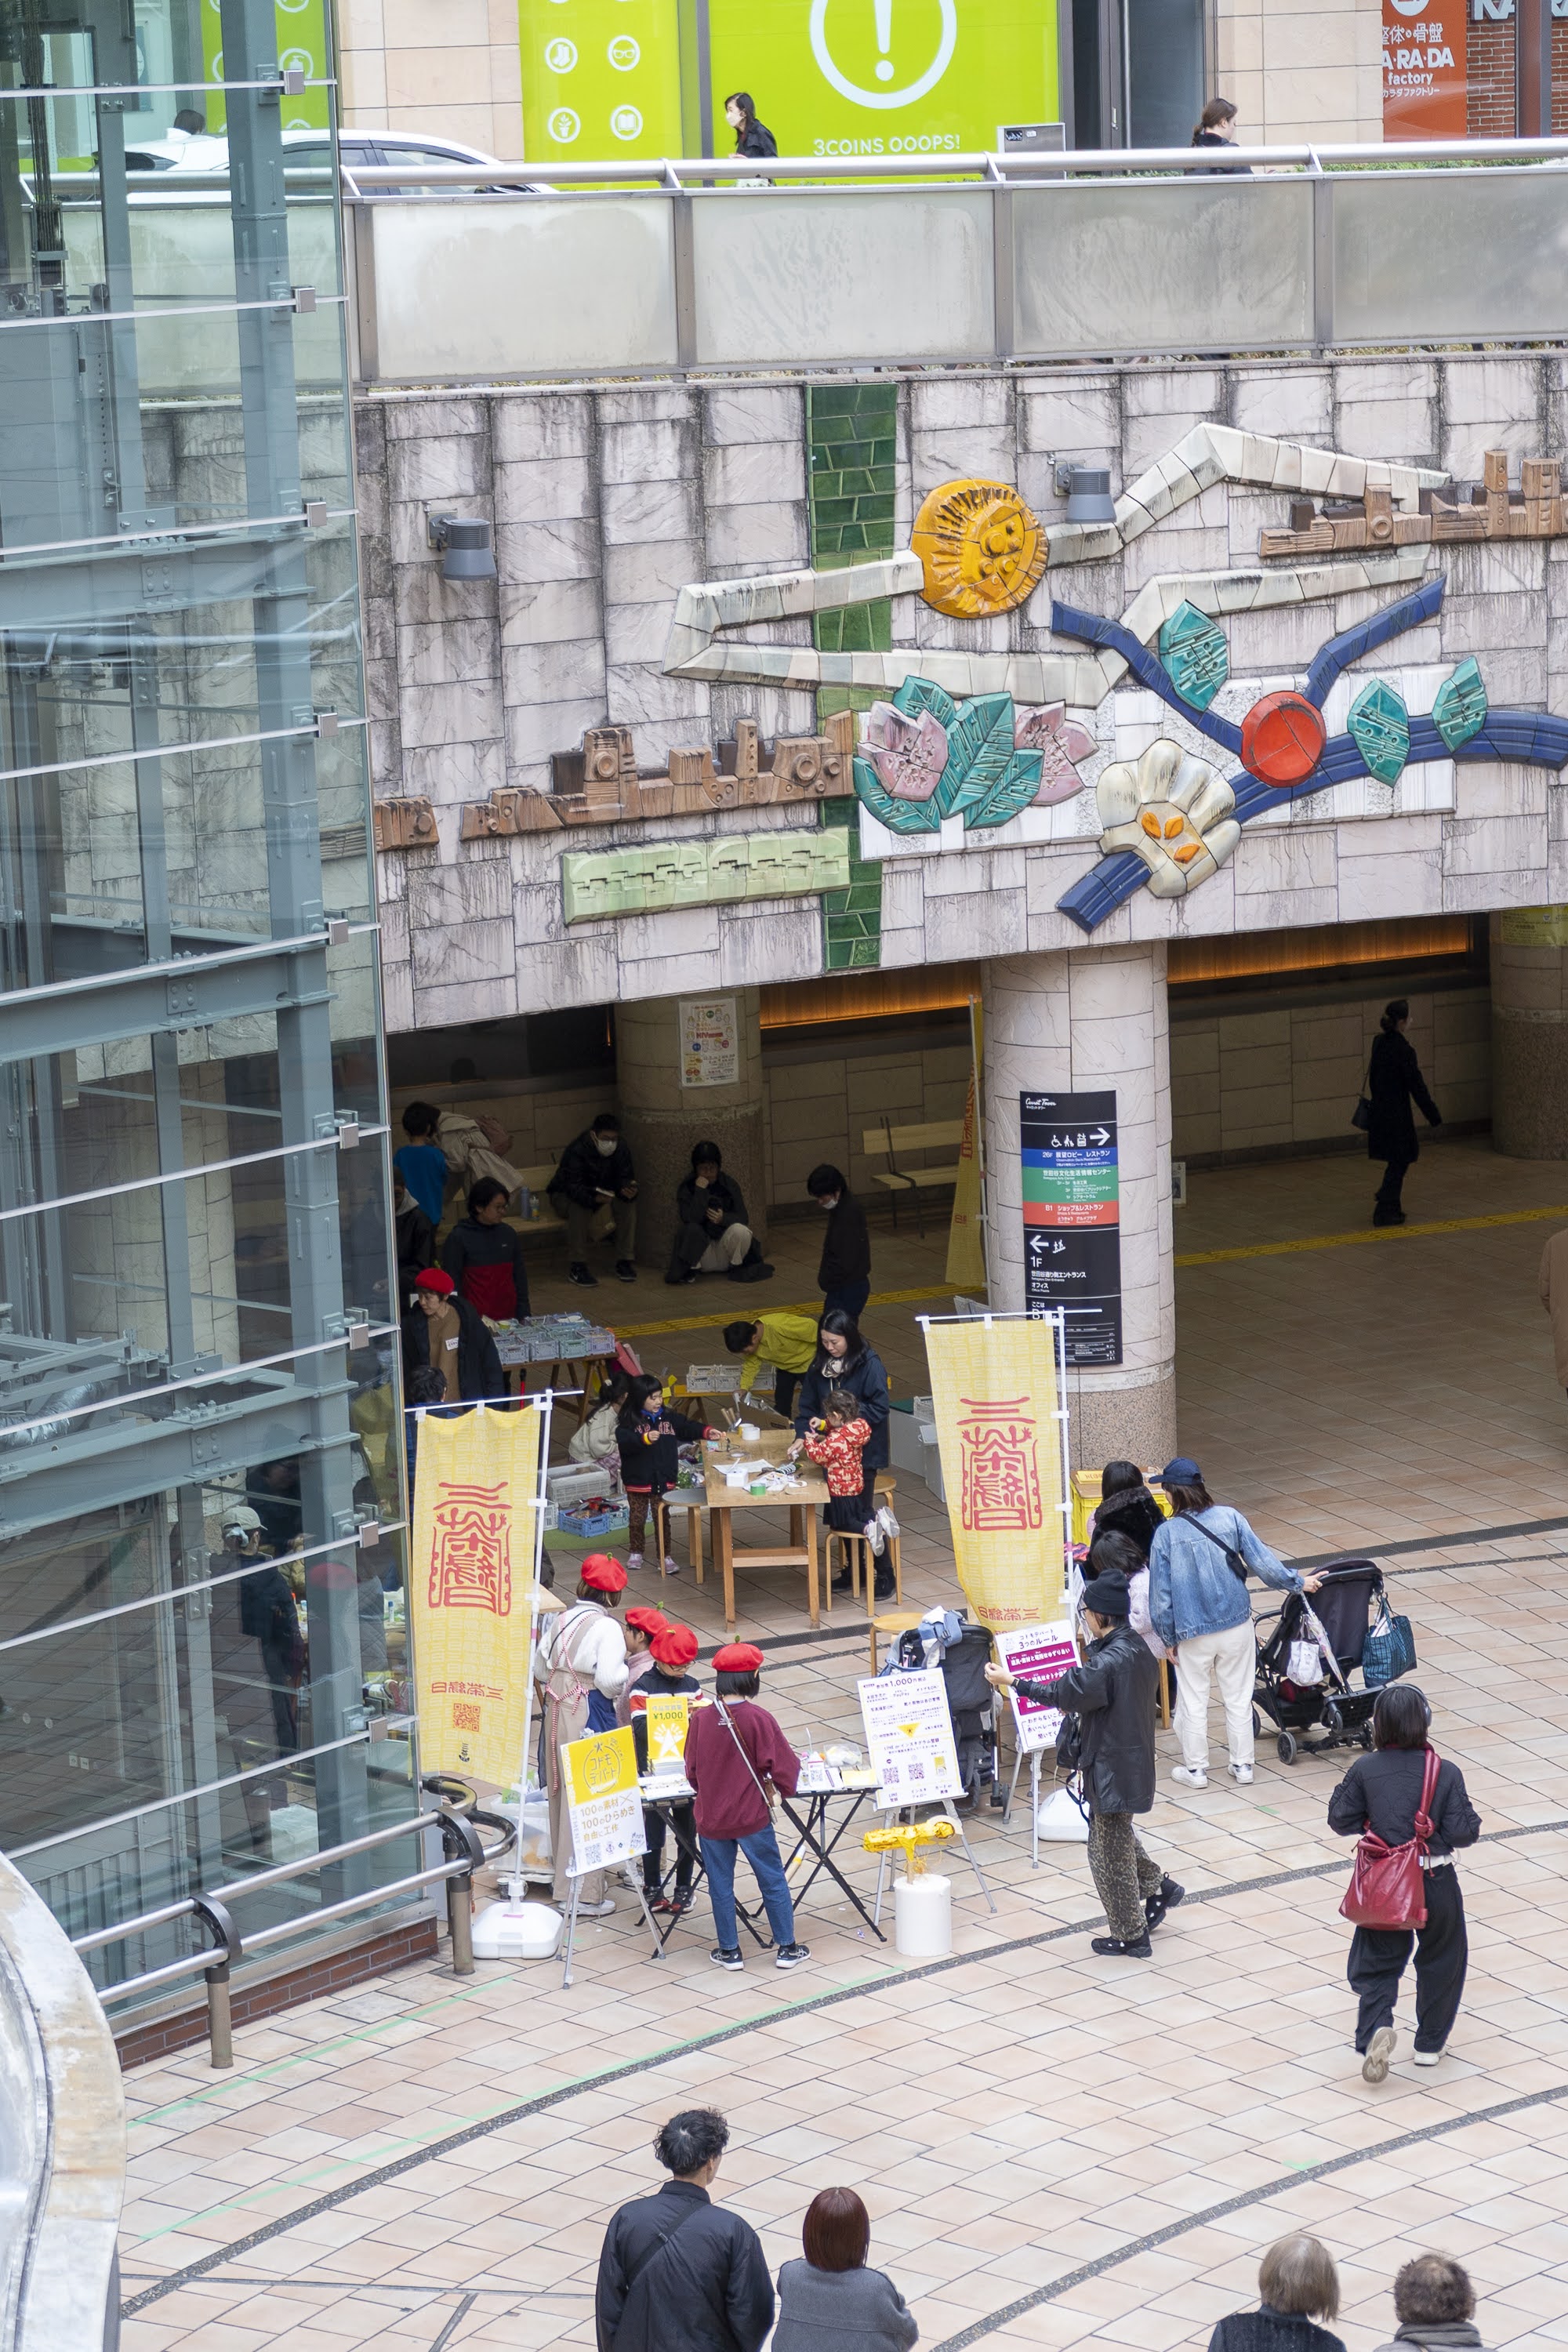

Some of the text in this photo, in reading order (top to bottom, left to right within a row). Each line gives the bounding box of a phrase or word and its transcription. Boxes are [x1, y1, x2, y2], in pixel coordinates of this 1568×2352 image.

[1388, 71, 1433, 85] factory
[1383, 87, 1440, 98] カラダファクトリー
[814, 134, 960, 156] 3COINS OOOPS!
[1030, 1256, 1043, 1268] 1F
[1019, 1635, 1058, 1650] 3つのルール
[654, 1711, 683, 1720] ¥1,000
[590, 1754, 612, 1771] コドモ
